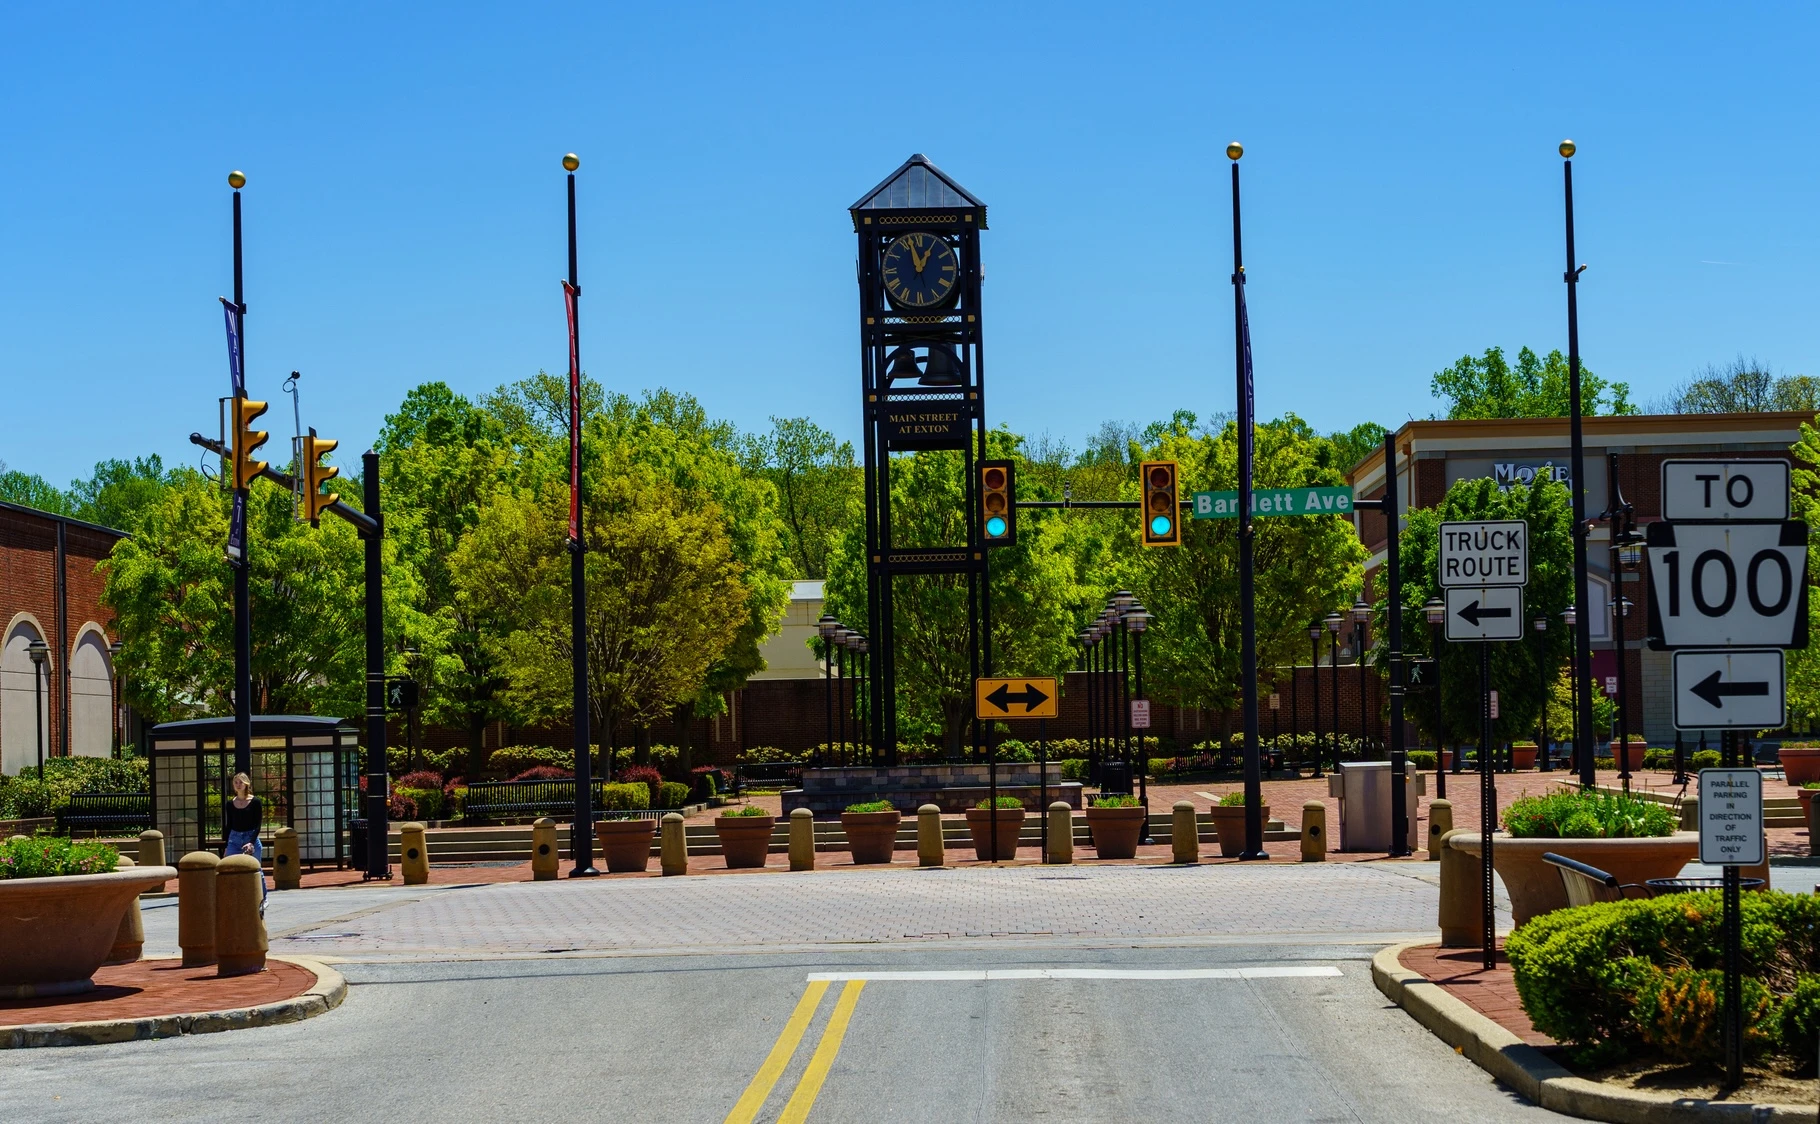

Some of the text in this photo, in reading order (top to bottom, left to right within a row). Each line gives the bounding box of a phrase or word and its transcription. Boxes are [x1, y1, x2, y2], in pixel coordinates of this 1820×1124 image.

[889, 413, 959, 423] MAIN STREET
[898, 424, 949, 434] AT EXTON
[1695, 474, 1754, 508] TO
[1197, 491, 1349, 514] Barlett Ave
[1445, 530, 1521, 552] TRUCK
[1446, 556, 1520, 577] ROUTE
[1662, 548, 1793, 618] 100
